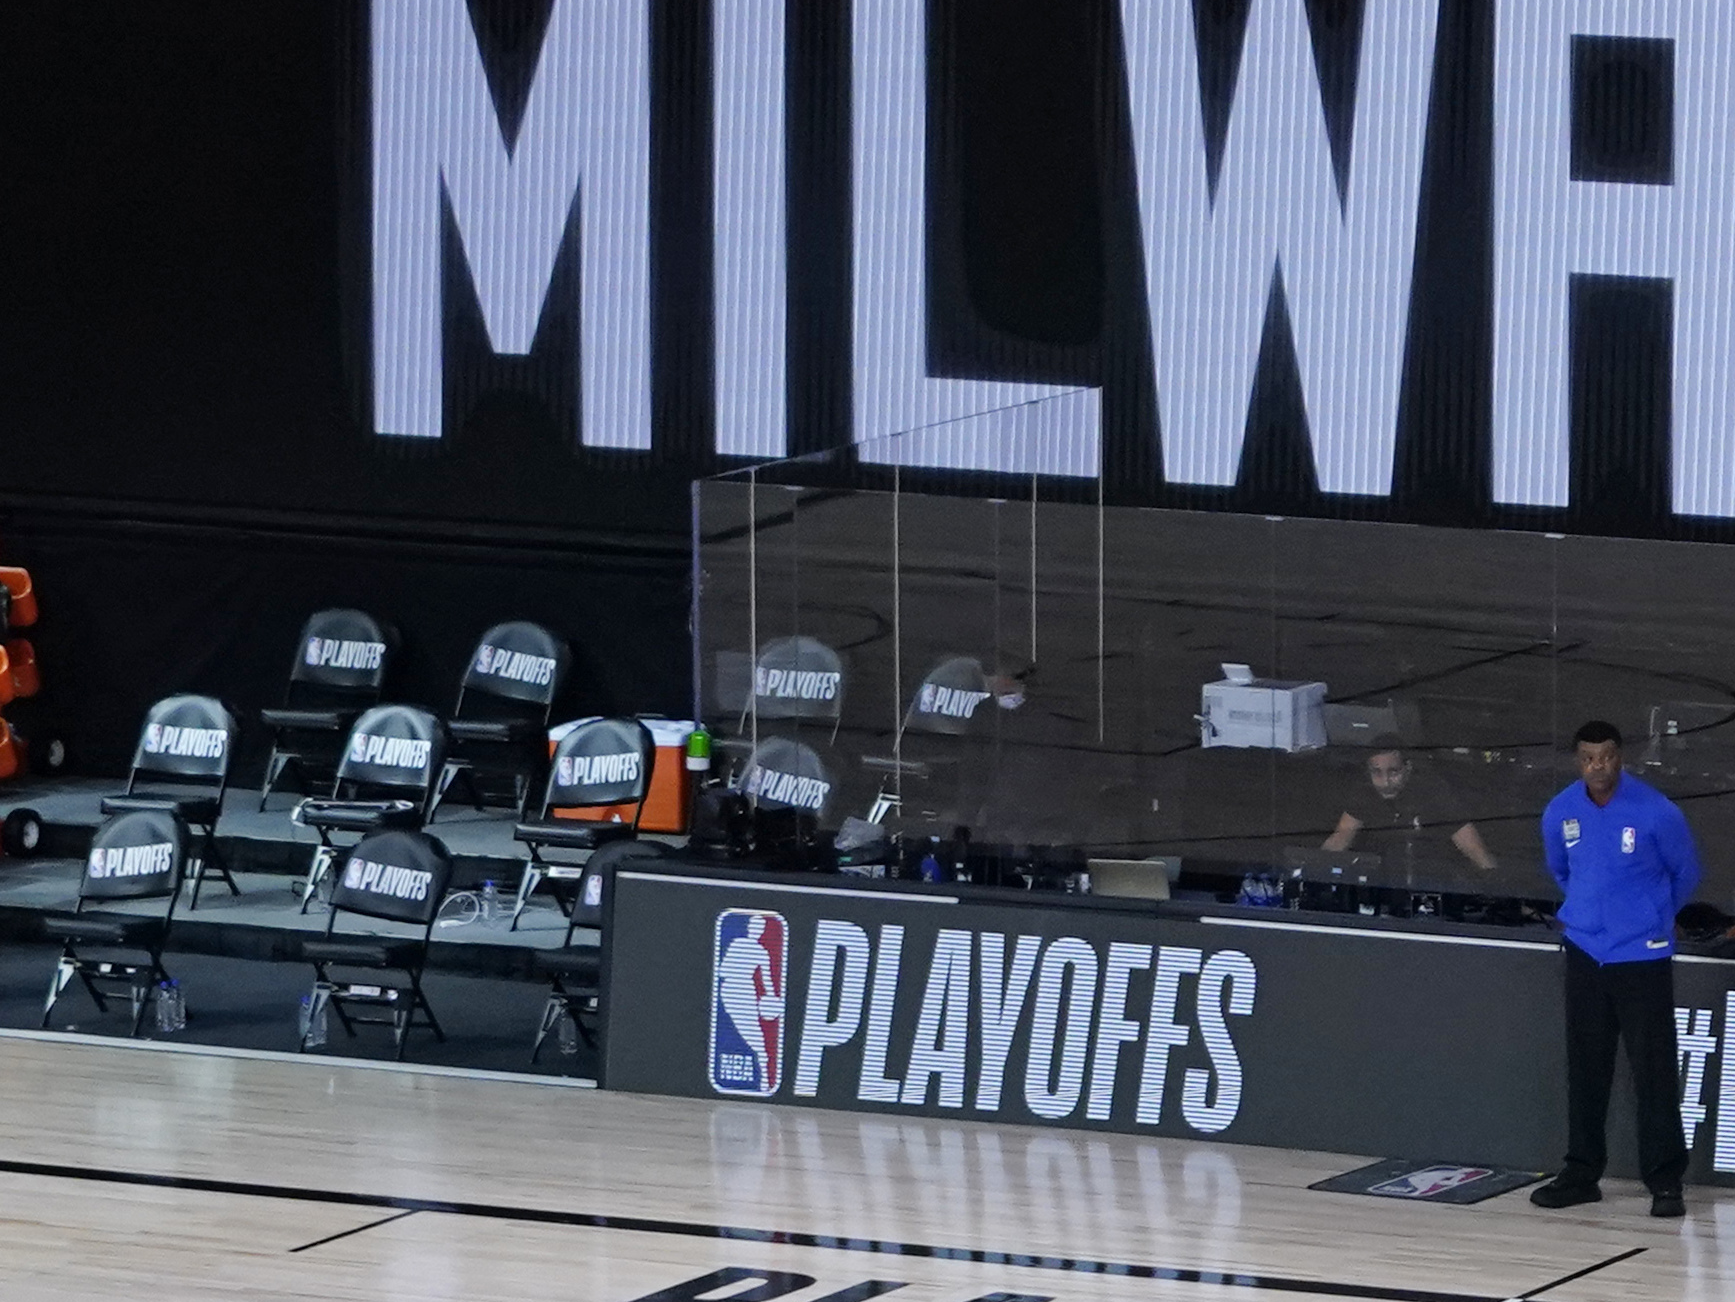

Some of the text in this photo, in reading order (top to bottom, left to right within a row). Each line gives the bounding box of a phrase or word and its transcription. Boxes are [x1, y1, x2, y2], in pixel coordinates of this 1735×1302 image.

[320, 640, 386, 670] PLAYOFFS
[489, 648, 556, 685] PLAYOFFS
[766, 669, 840, 700] PLAYOFFS
[933, 687, 991, 719] PLAYO
[159, 725, 228, 758] PLAYOFFS
[365, 735, 431, 769] PLAYOFFS
[572, 751, 641, 786] PLAYOFFS
[759, 770, 831, 809] PLAYOFFS
[105, 842, 173, 878] PLAYOFFS
[360, 861, 433, 901] PLAYOFFS
[793, 919, 1256, 1134] PLAYOFFS
